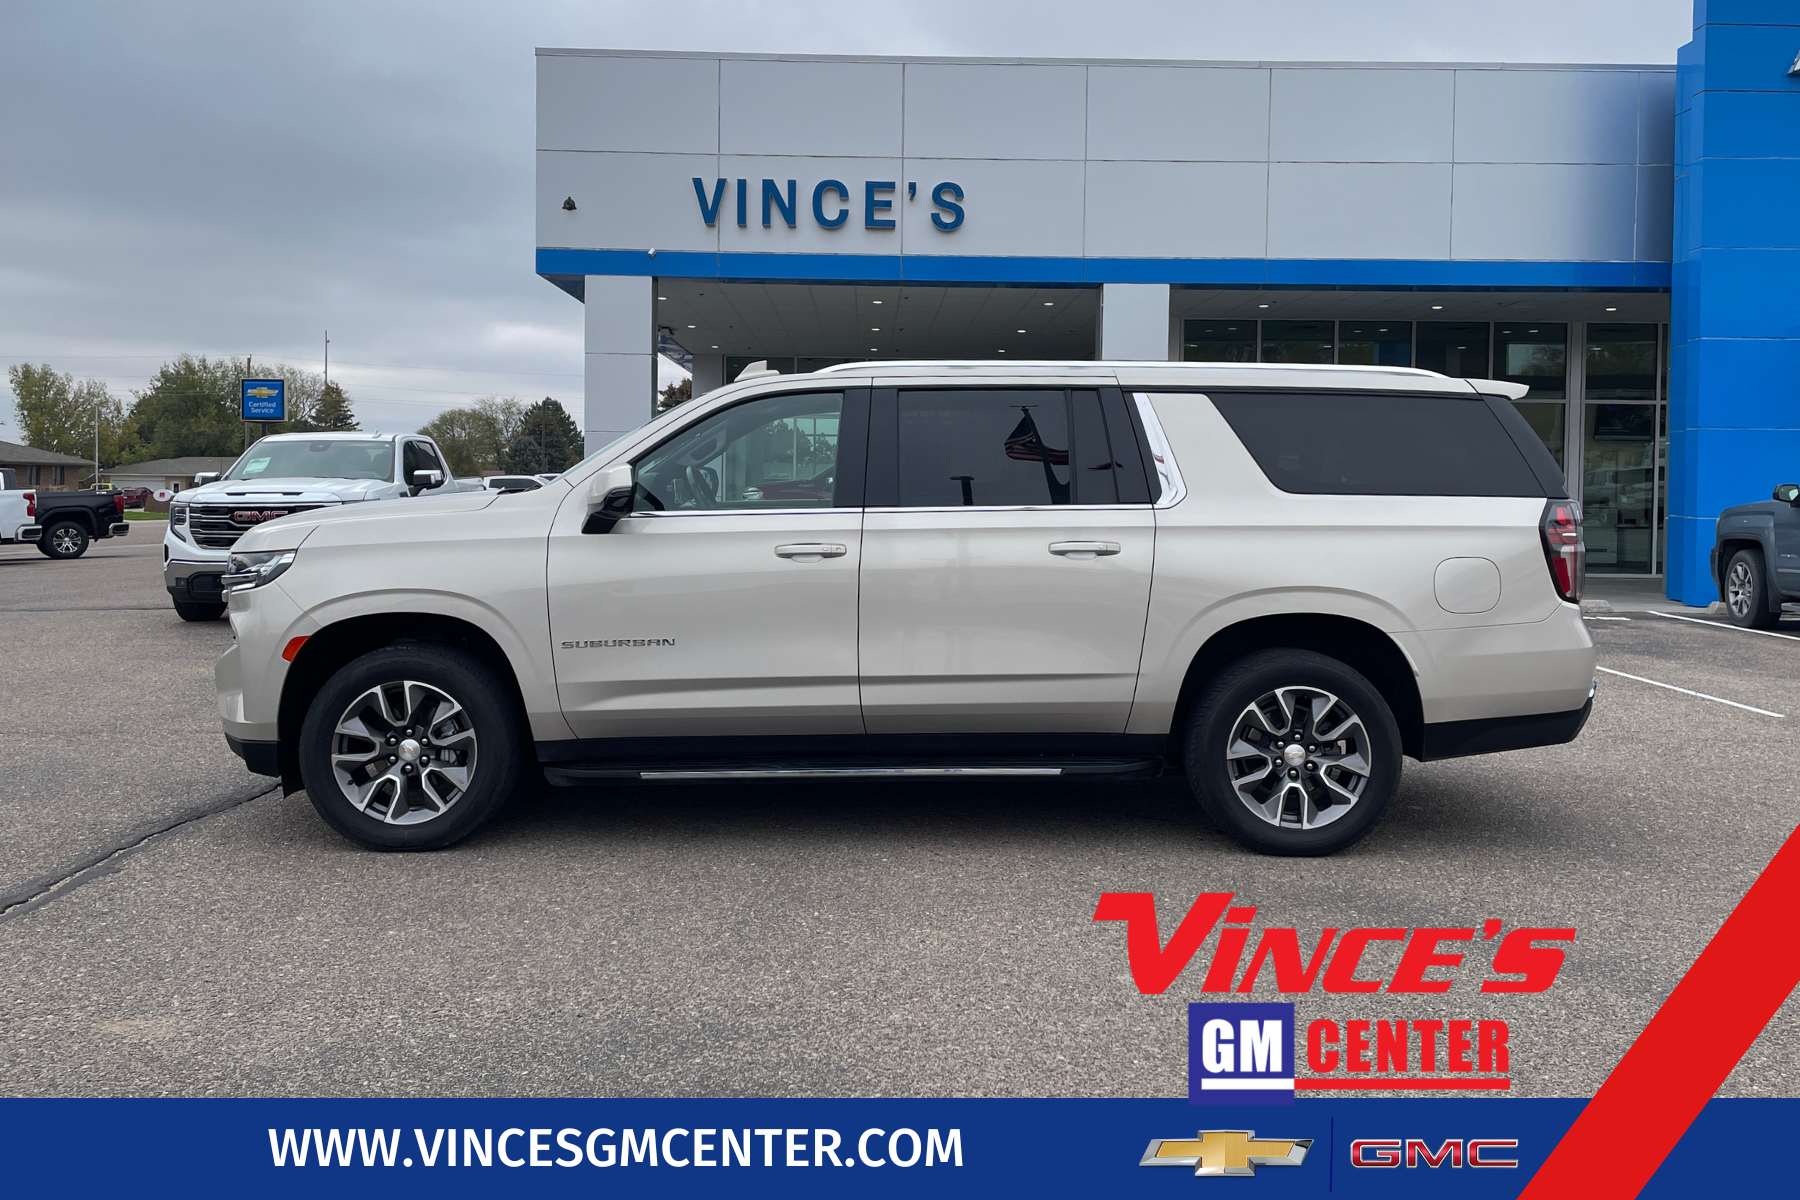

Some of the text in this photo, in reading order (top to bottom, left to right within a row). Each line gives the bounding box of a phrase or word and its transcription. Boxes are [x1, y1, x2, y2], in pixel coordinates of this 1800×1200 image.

[692, 177, 966, 232] VINCE'S
[233, 510, 289, 521] GMC
[561, 638, 676, 649] SUBURBAN
